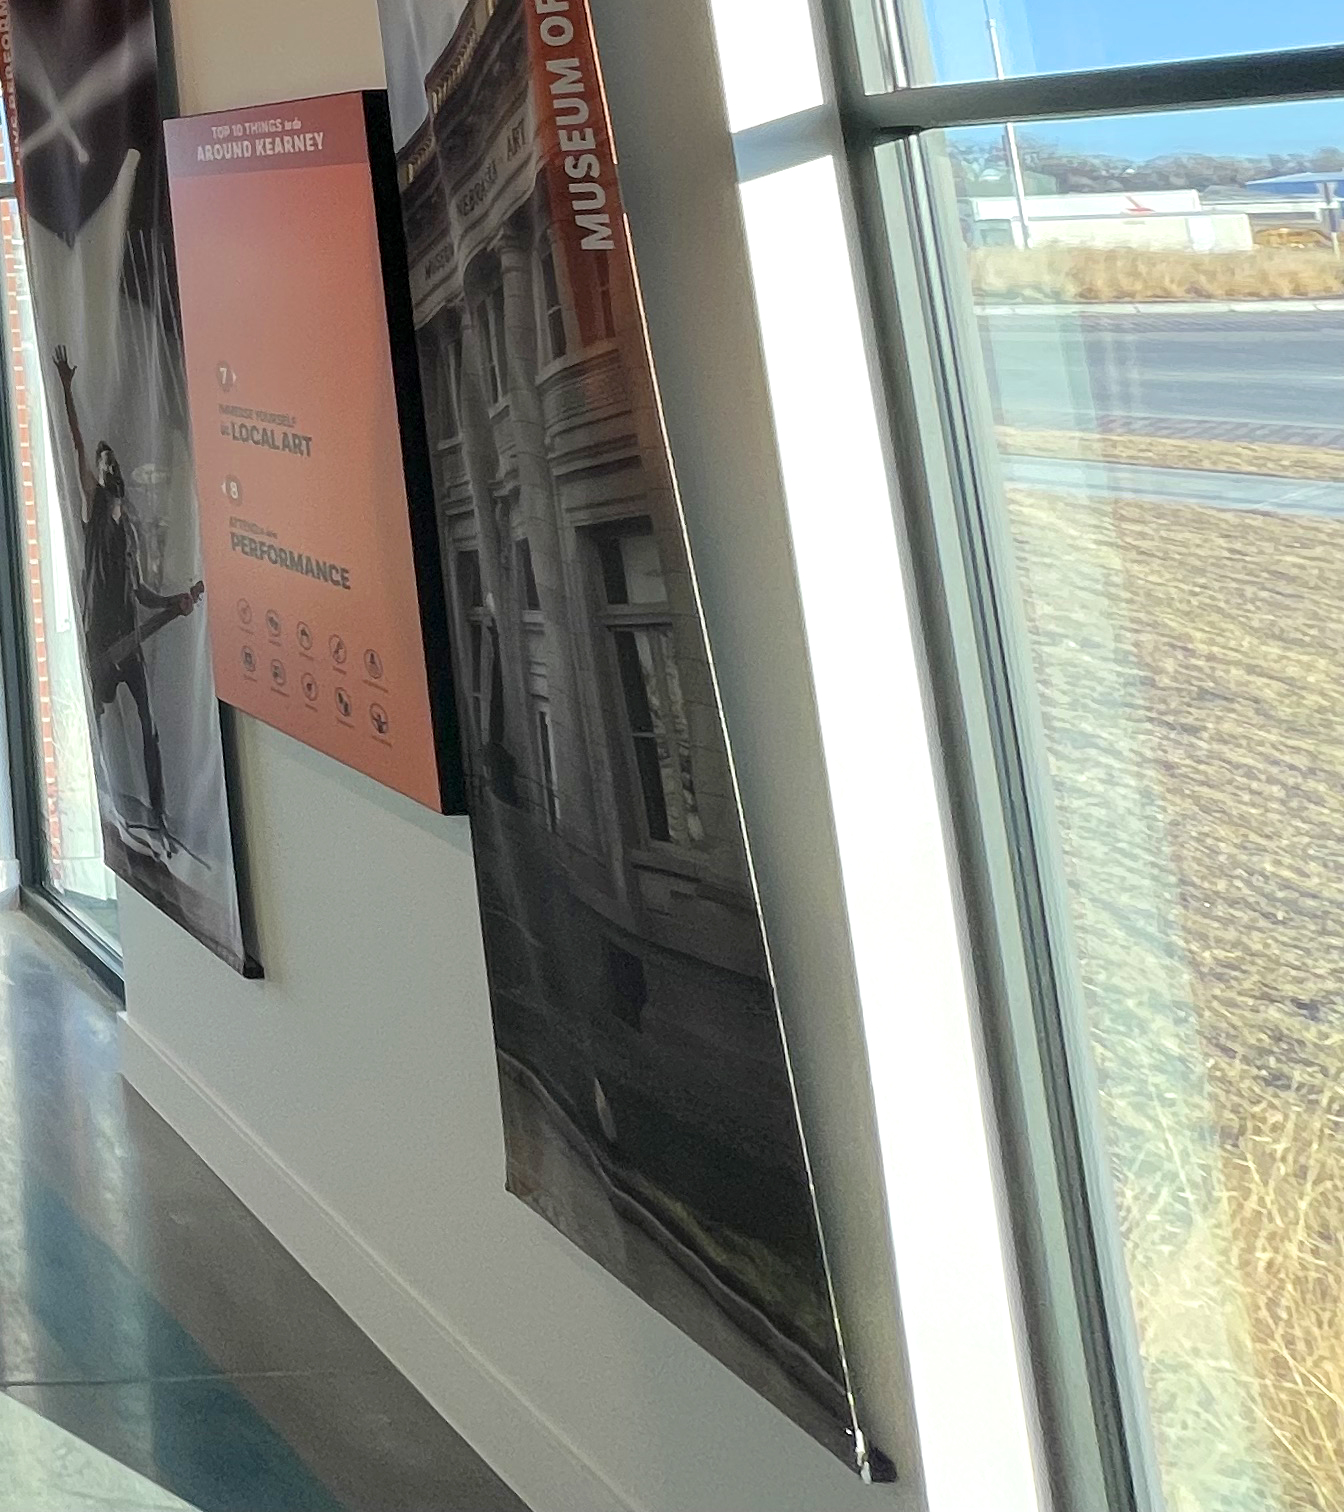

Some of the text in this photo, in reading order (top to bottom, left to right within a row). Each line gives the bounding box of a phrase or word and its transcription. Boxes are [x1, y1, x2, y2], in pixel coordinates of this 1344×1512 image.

[197, 131, 324, 162] AROUND KEARNEY
[211, 125, 231, 140] TOP
[232, 124, 243, 137] 10
[245, 118, 283, 135] THINGS
[544, 56, 616, 250] MUSEUM
[230, 420, 280, 450] LOCAL
[281, 431, 312, 458] ART
[229, 530, 352, 591] PERFORMANCE
